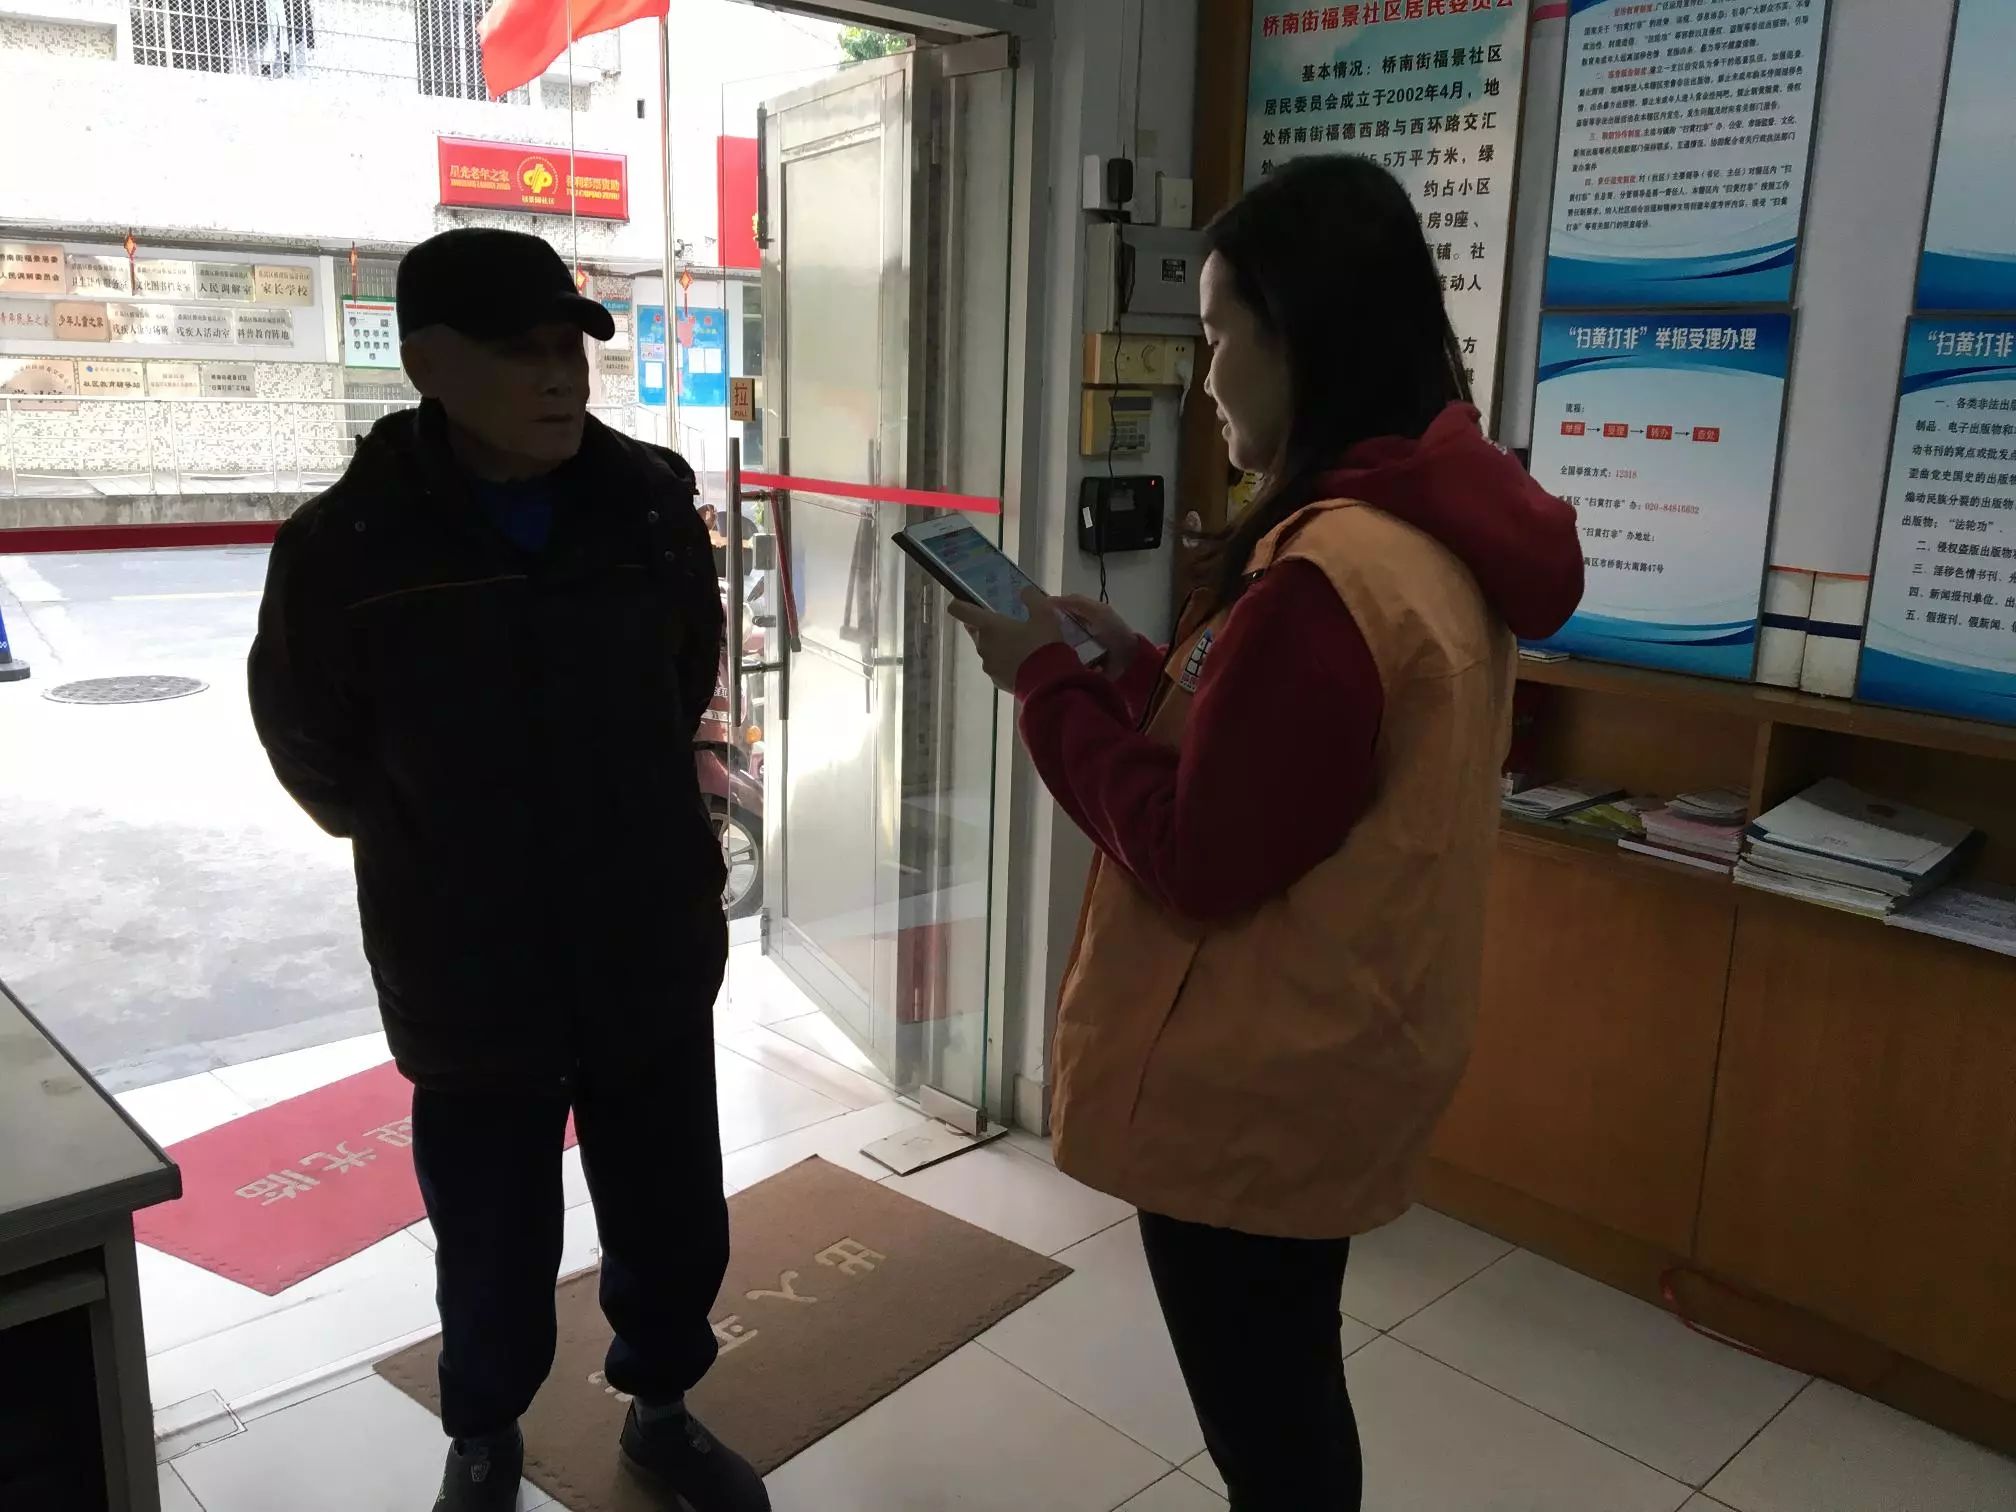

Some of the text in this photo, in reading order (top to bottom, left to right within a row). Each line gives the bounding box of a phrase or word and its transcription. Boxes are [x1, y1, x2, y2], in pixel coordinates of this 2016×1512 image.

[1302, 45, 1503, 82] 基本情况：桥南街福景社区
[1264, 77, 1500, 116] 居民委员会成立于2002年4月，地
[1262, 111, 1497, 146] 处桥南街福德西路与西环路交汇
[262, 282, 308, 297] 家长学校
[1928, 330, 2016, 358] “扫黄打非
[735, 382, 749, 406] 拉
